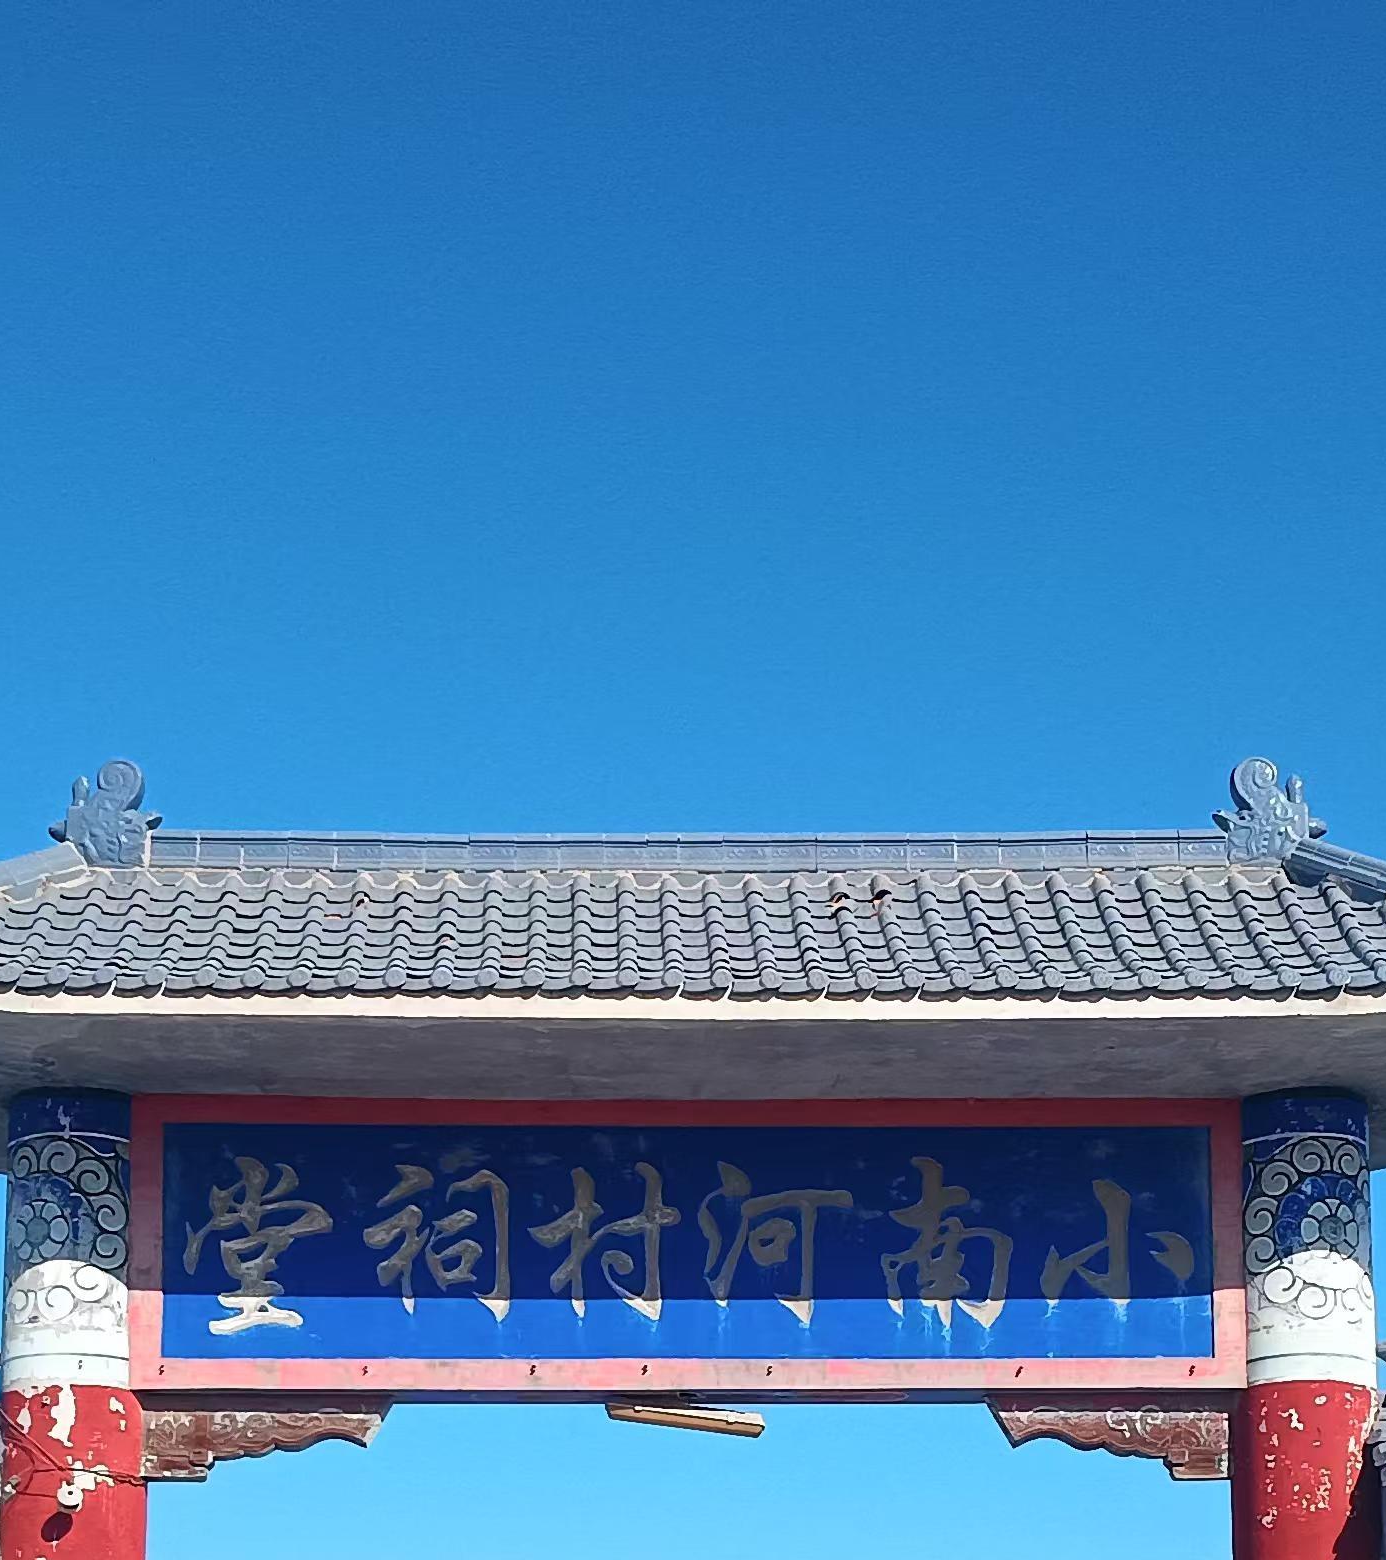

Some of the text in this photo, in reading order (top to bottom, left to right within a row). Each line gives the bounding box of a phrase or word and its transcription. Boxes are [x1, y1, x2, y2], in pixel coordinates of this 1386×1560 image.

[183, 1156, 1196, 1336] 小南河村祠堂
